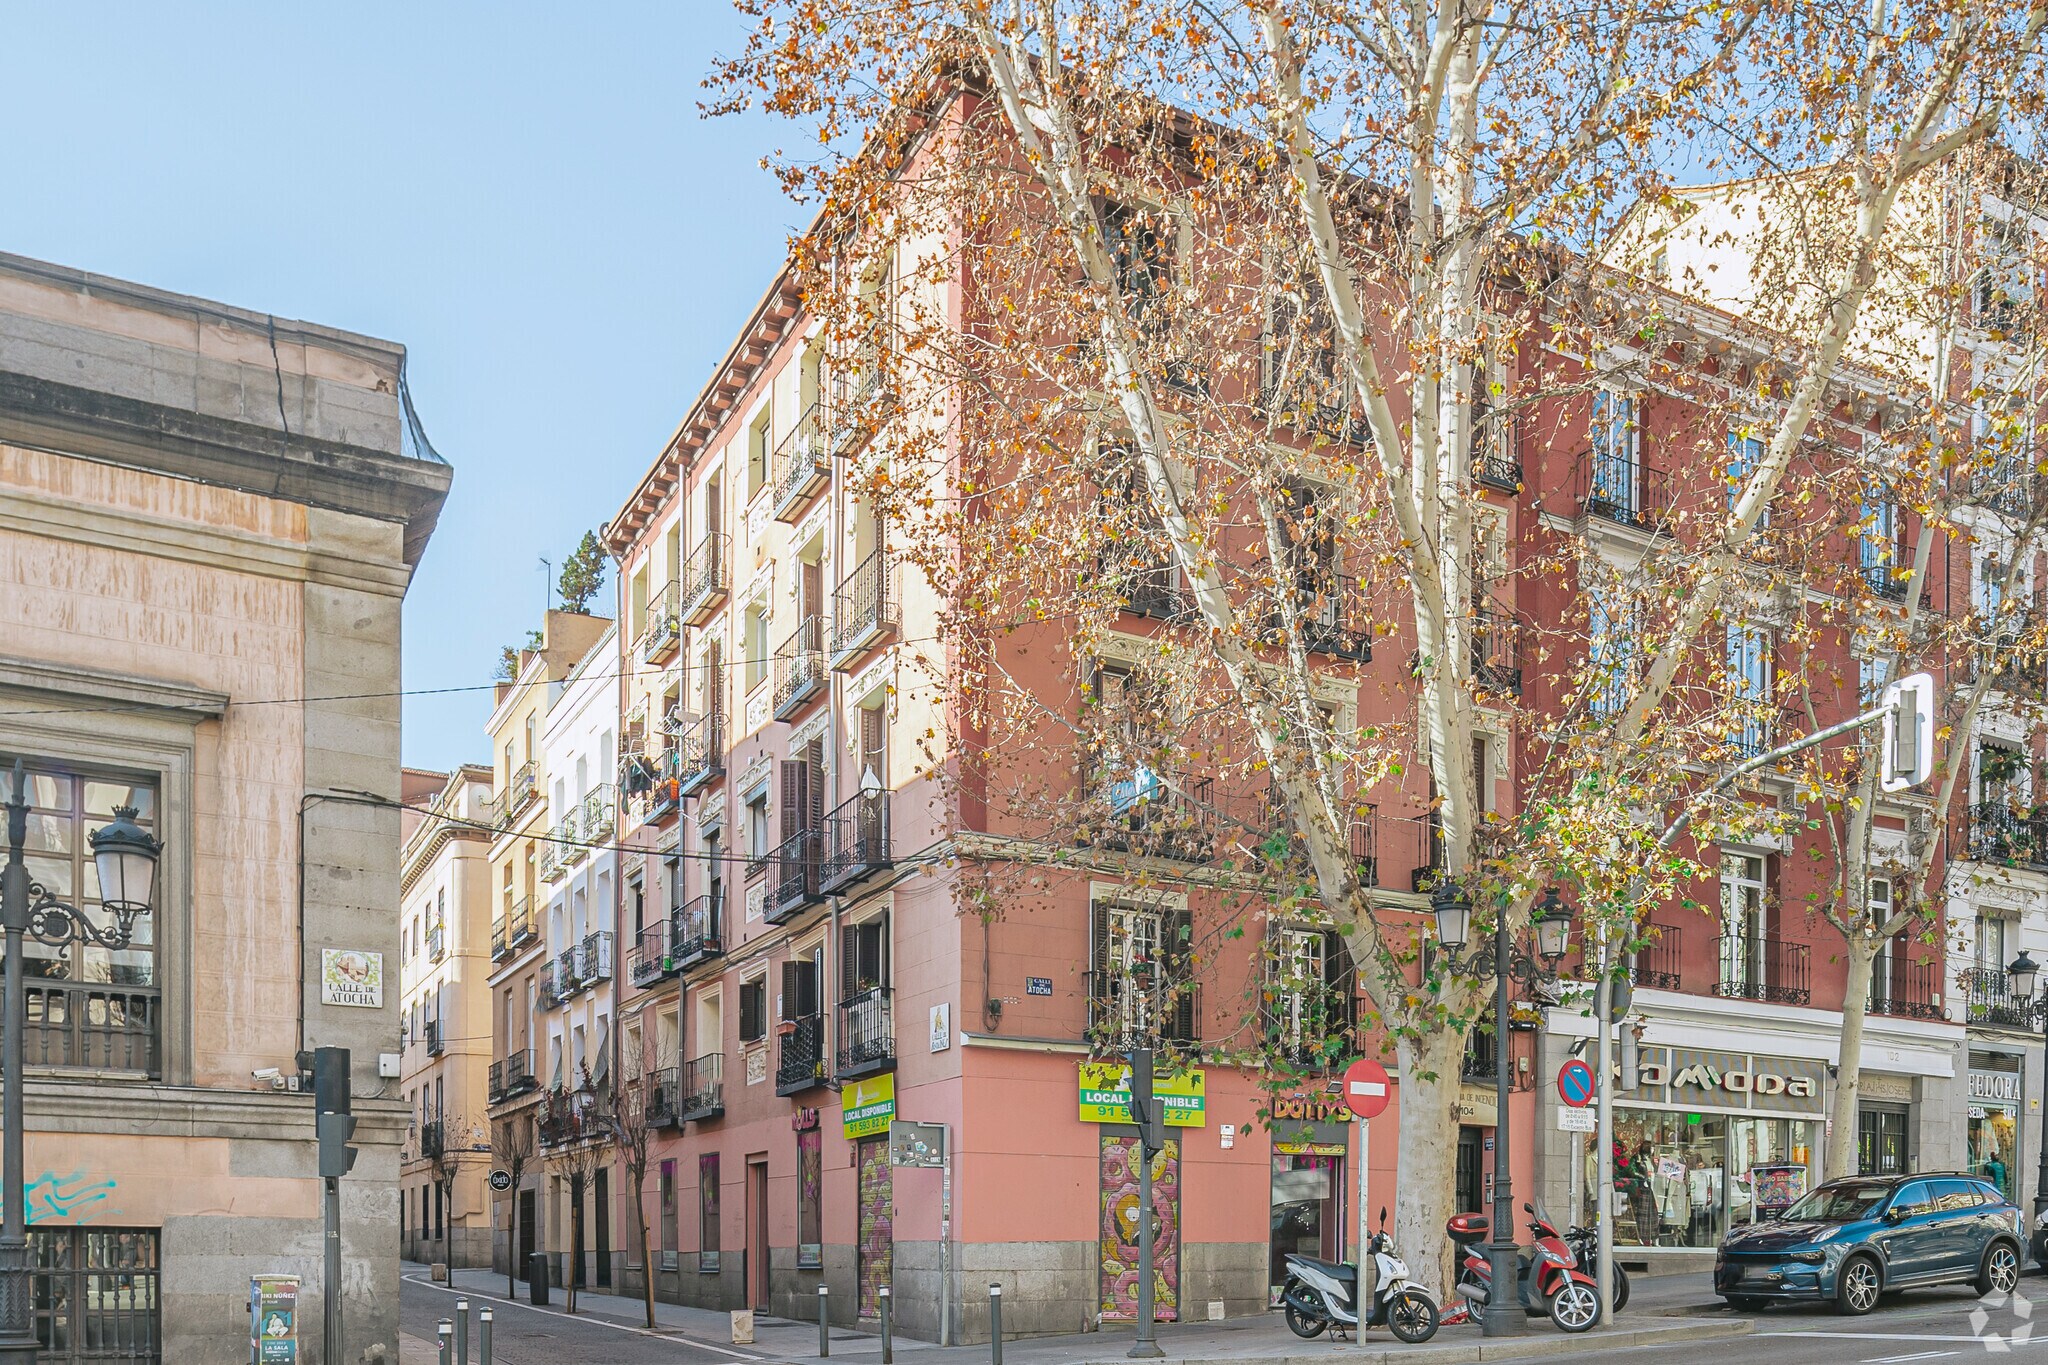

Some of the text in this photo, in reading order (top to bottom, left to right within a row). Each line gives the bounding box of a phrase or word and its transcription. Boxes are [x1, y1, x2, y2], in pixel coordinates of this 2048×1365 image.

[329, 983, 362, 993] CALLE
[1028, 986, 1051, 994] ATOCHA
[330, 992, 375, 1005] ATOCHA
[1887, 1052, 1900, 1061] 102
[1968, 1074, 2021, 1100] FEDORA
[1086, 1092, 1126, 1104] LOCAL
[845, 1103, 892, 1122] LOCAL DISPONIBLE
[1098, 1106, 1115, 1116] 91
[1175, 1110, 1192, 1120] 27
[1460, 1106, 1474, 1116] 104
[1968, 1106, 1985, 1119] SEDA
[850, 1124, 857, 1132] 91
[859, 1120, 870, 1130] 593
[872, 1118, 879, 1128] 82
[881, 1116, 889, 1126] 27
